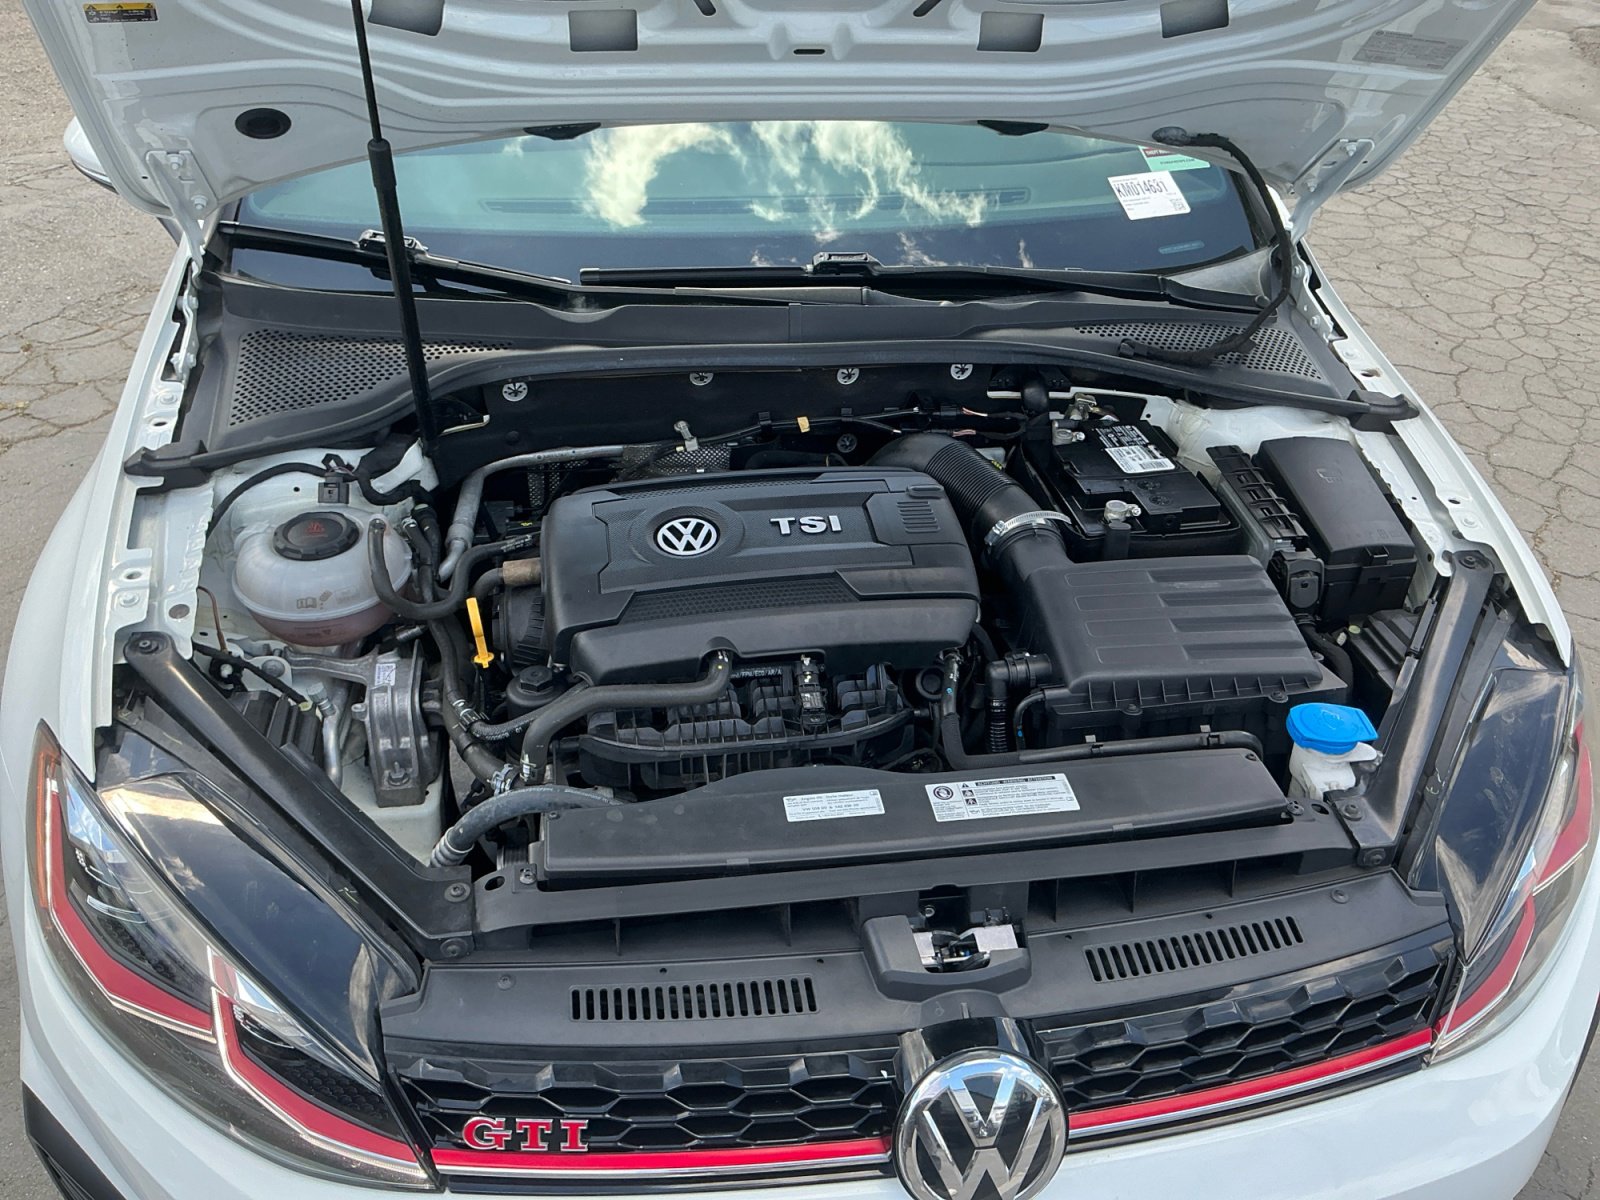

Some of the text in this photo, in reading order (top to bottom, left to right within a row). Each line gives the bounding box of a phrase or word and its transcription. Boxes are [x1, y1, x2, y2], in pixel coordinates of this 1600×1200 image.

[1113, 180, 1168, 198] KM014631
[656, 516, 718, 556] VW
[769, 514, 842, 536] TSI
[462, 1116, 589, 1152] GTI
[897, 1050, 1066, 1200] VW
